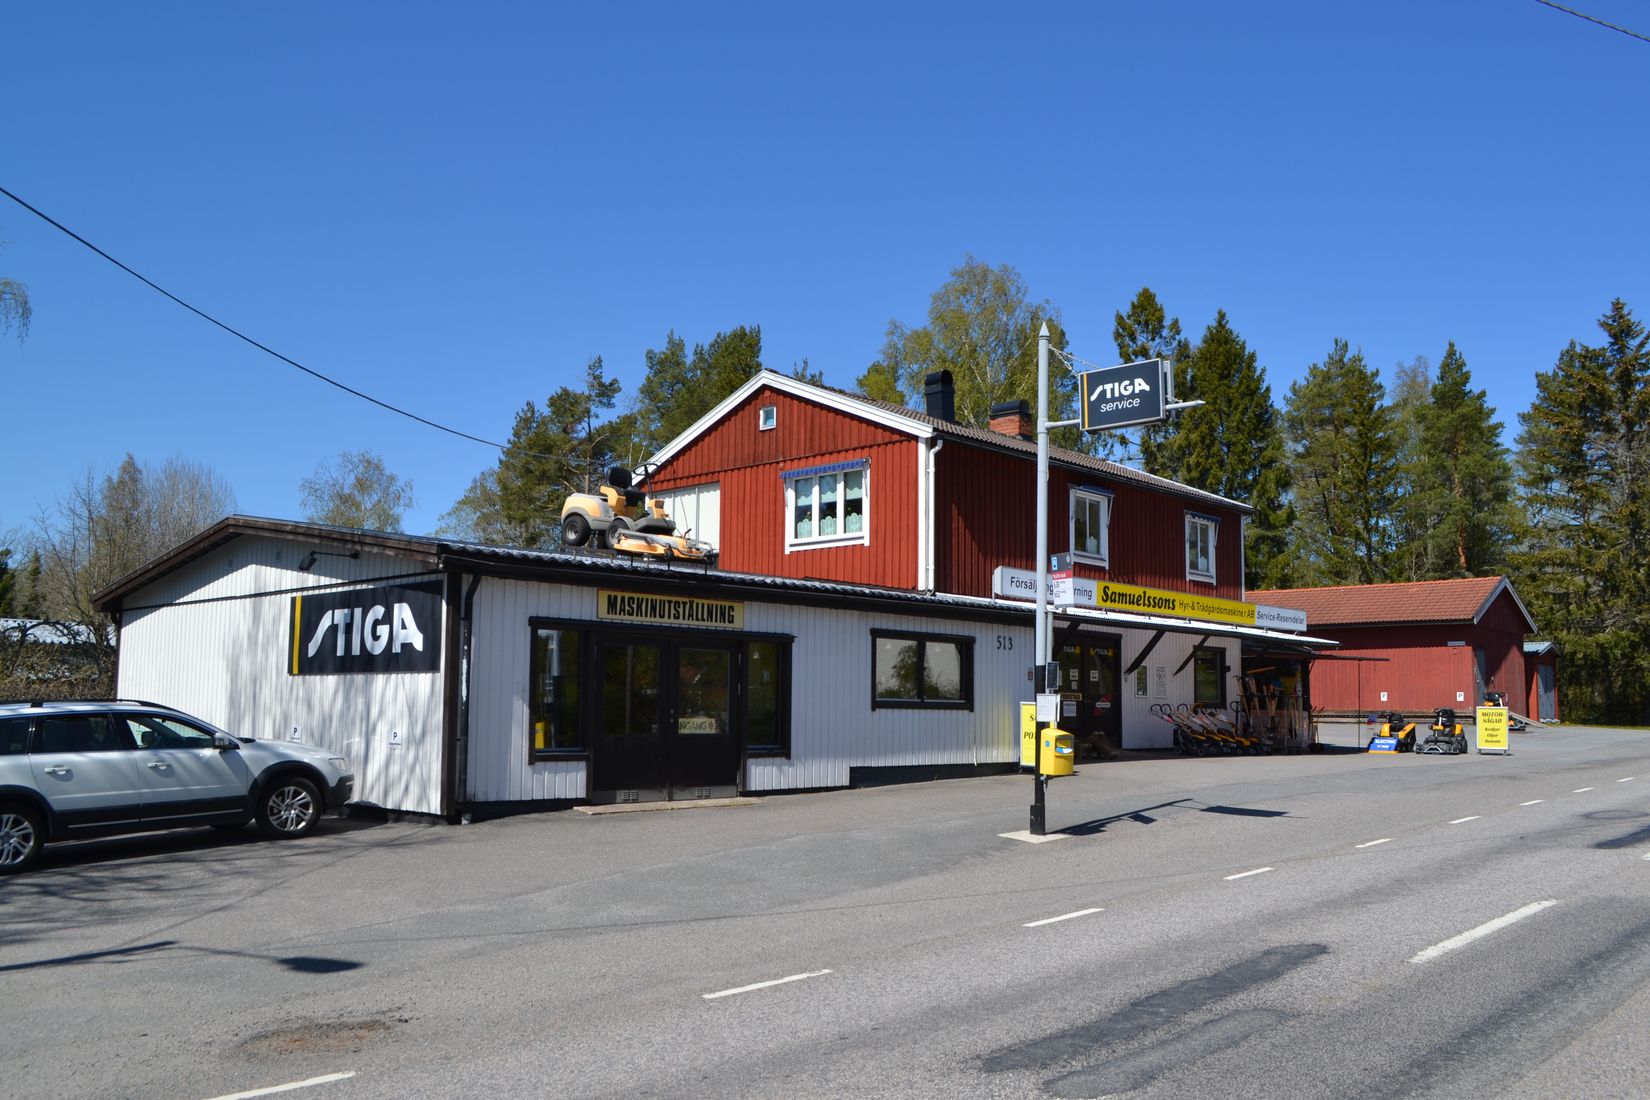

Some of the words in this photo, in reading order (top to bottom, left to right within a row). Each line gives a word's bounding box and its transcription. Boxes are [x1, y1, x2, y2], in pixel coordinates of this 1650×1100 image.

[1090, 378, 1150, 402] STIGA
[1100, 397, 1141, 413] service
[1101, 585, 1177, 611] Samuelssons
[607, 594, 735, 624] MASKINUTSTÄLLNING
[1247, 611, 1255, 619] AB
[307, 602, 424, 658] STIGA
[996, 635, 1014, 651] 513
[293, 727, 298, 736] P
[393, 731, 398, 740] P
